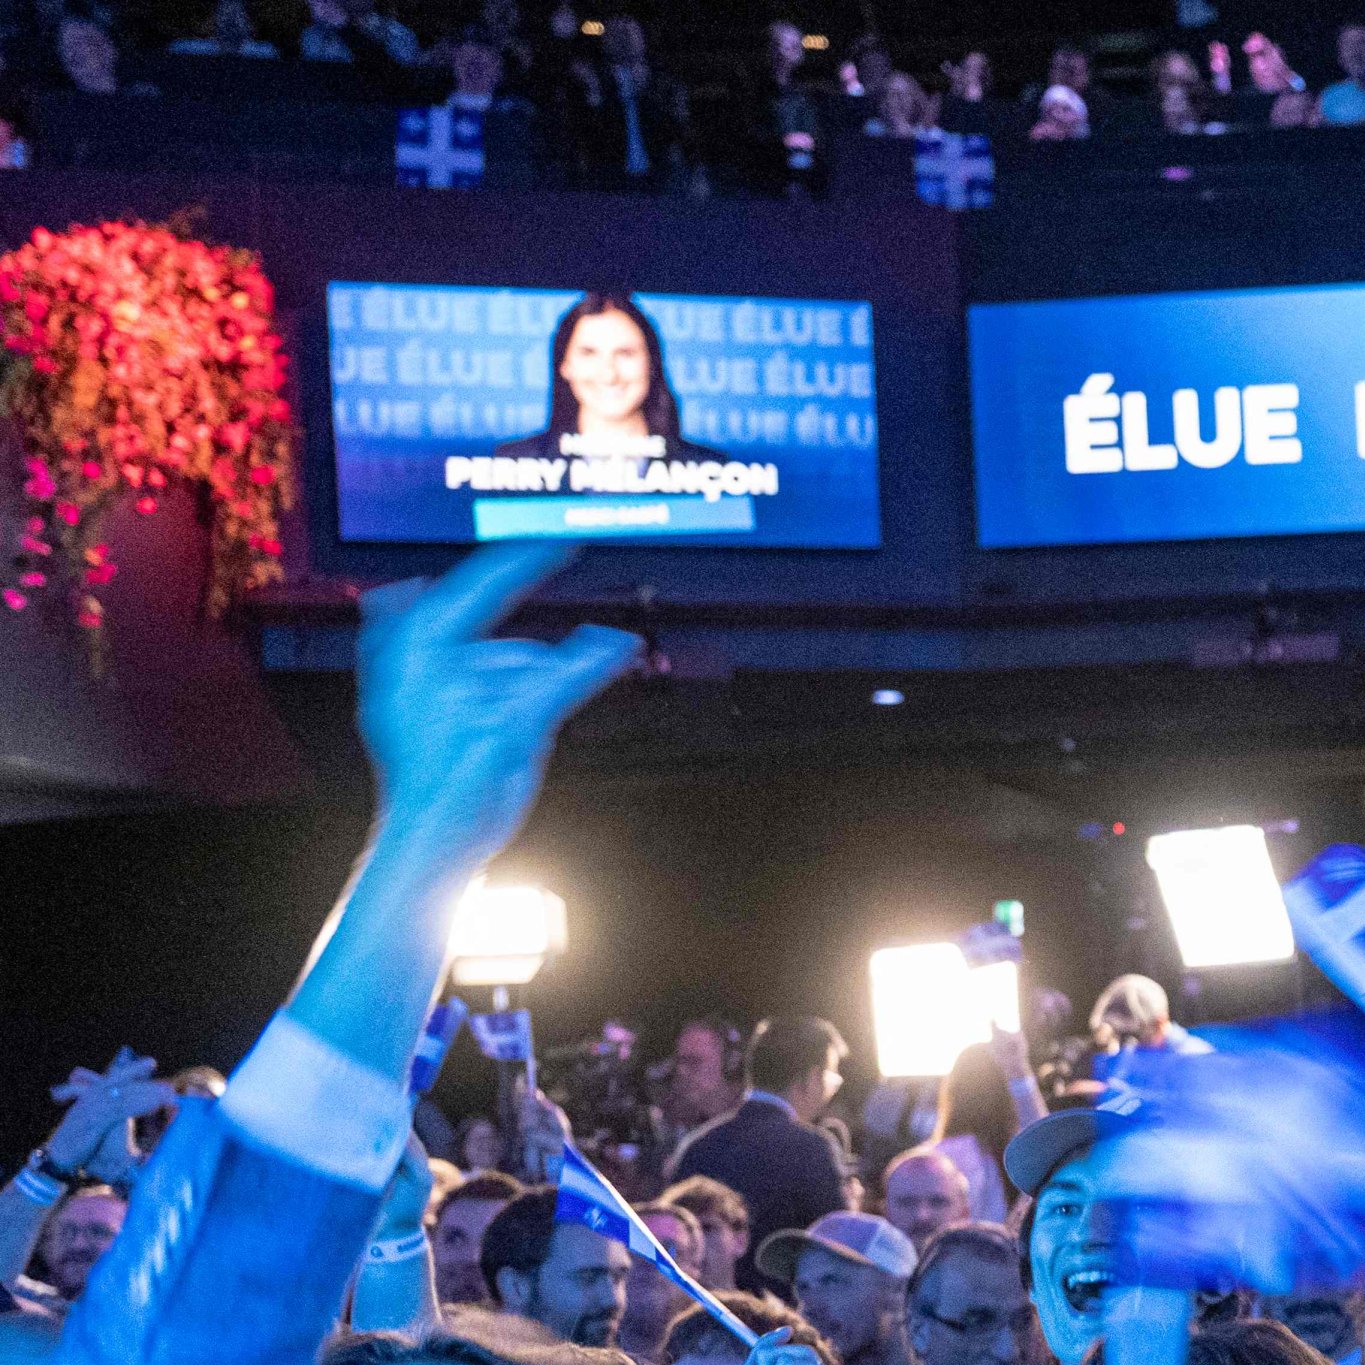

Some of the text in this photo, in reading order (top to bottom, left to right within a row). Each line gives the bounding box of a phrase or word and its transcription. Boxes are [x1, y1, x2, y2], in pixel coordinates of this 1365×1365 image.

[360, 286, 477, 333] ÉLUE
[732, 299, 843, 347] ÉLUE
[396, 336, 515, 388] ÉLUE
[763, 350, 872, 398] ÉLUE
[1062, 373, 1302, 475] ÉLUE
[445, 455, 569, 492] PERRY
